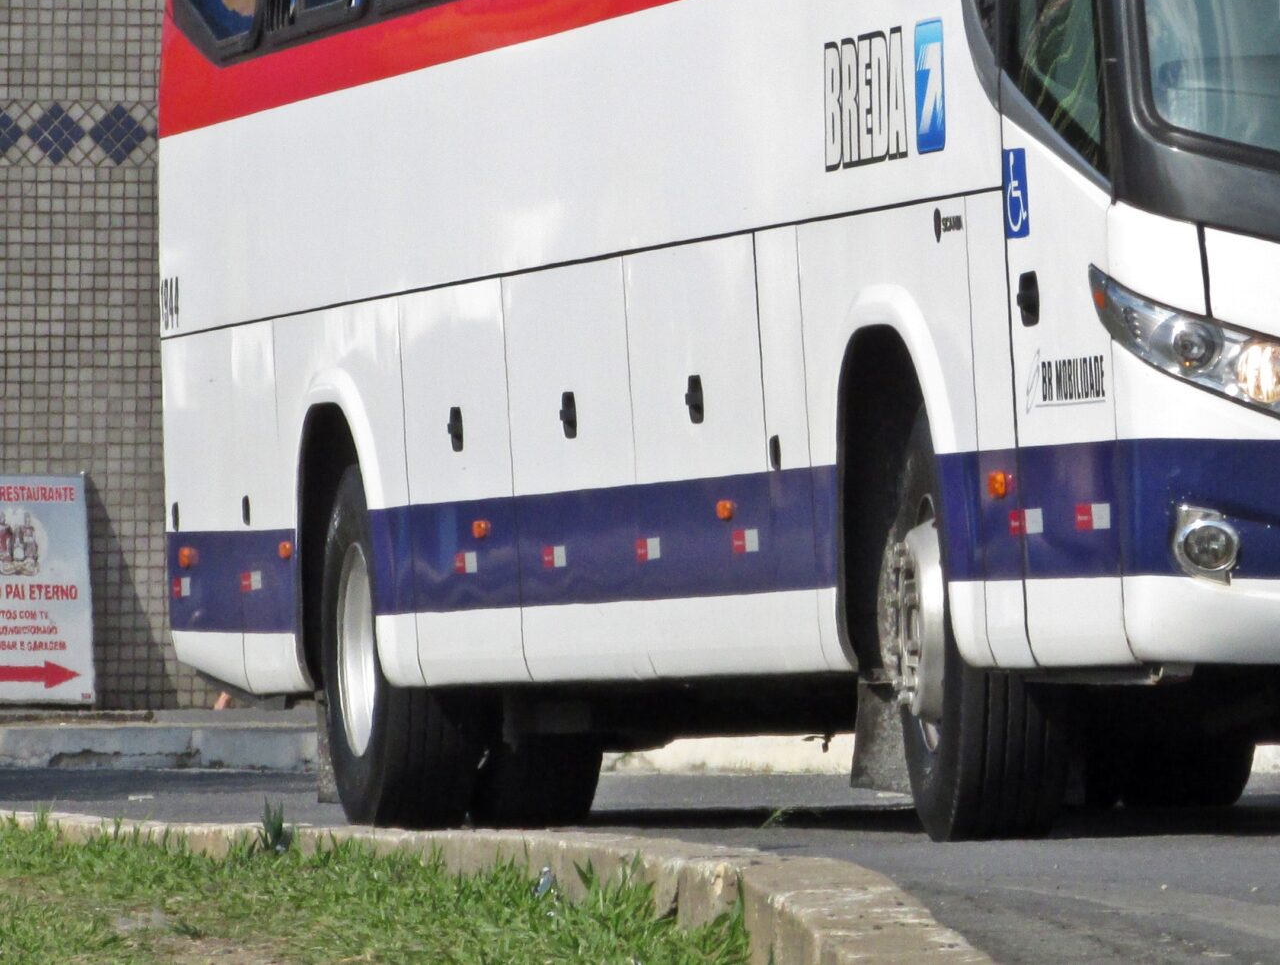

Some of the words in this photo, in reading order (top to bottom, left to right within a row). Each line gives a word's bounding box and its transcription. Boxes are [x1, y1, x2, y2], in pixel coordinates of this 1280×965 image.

[824, 26, 908, 172] BREDA
[1041, 361, 1053, 401] BR
[1055, 355, 1105, 400] MOBILIDADE
[0, 486, 75, 501] RESTAURANTE
[5, 584, 24, 600] PAI
[29, 584, 79, 600] ETERNO
[0, 610, 17, 620] TOS
